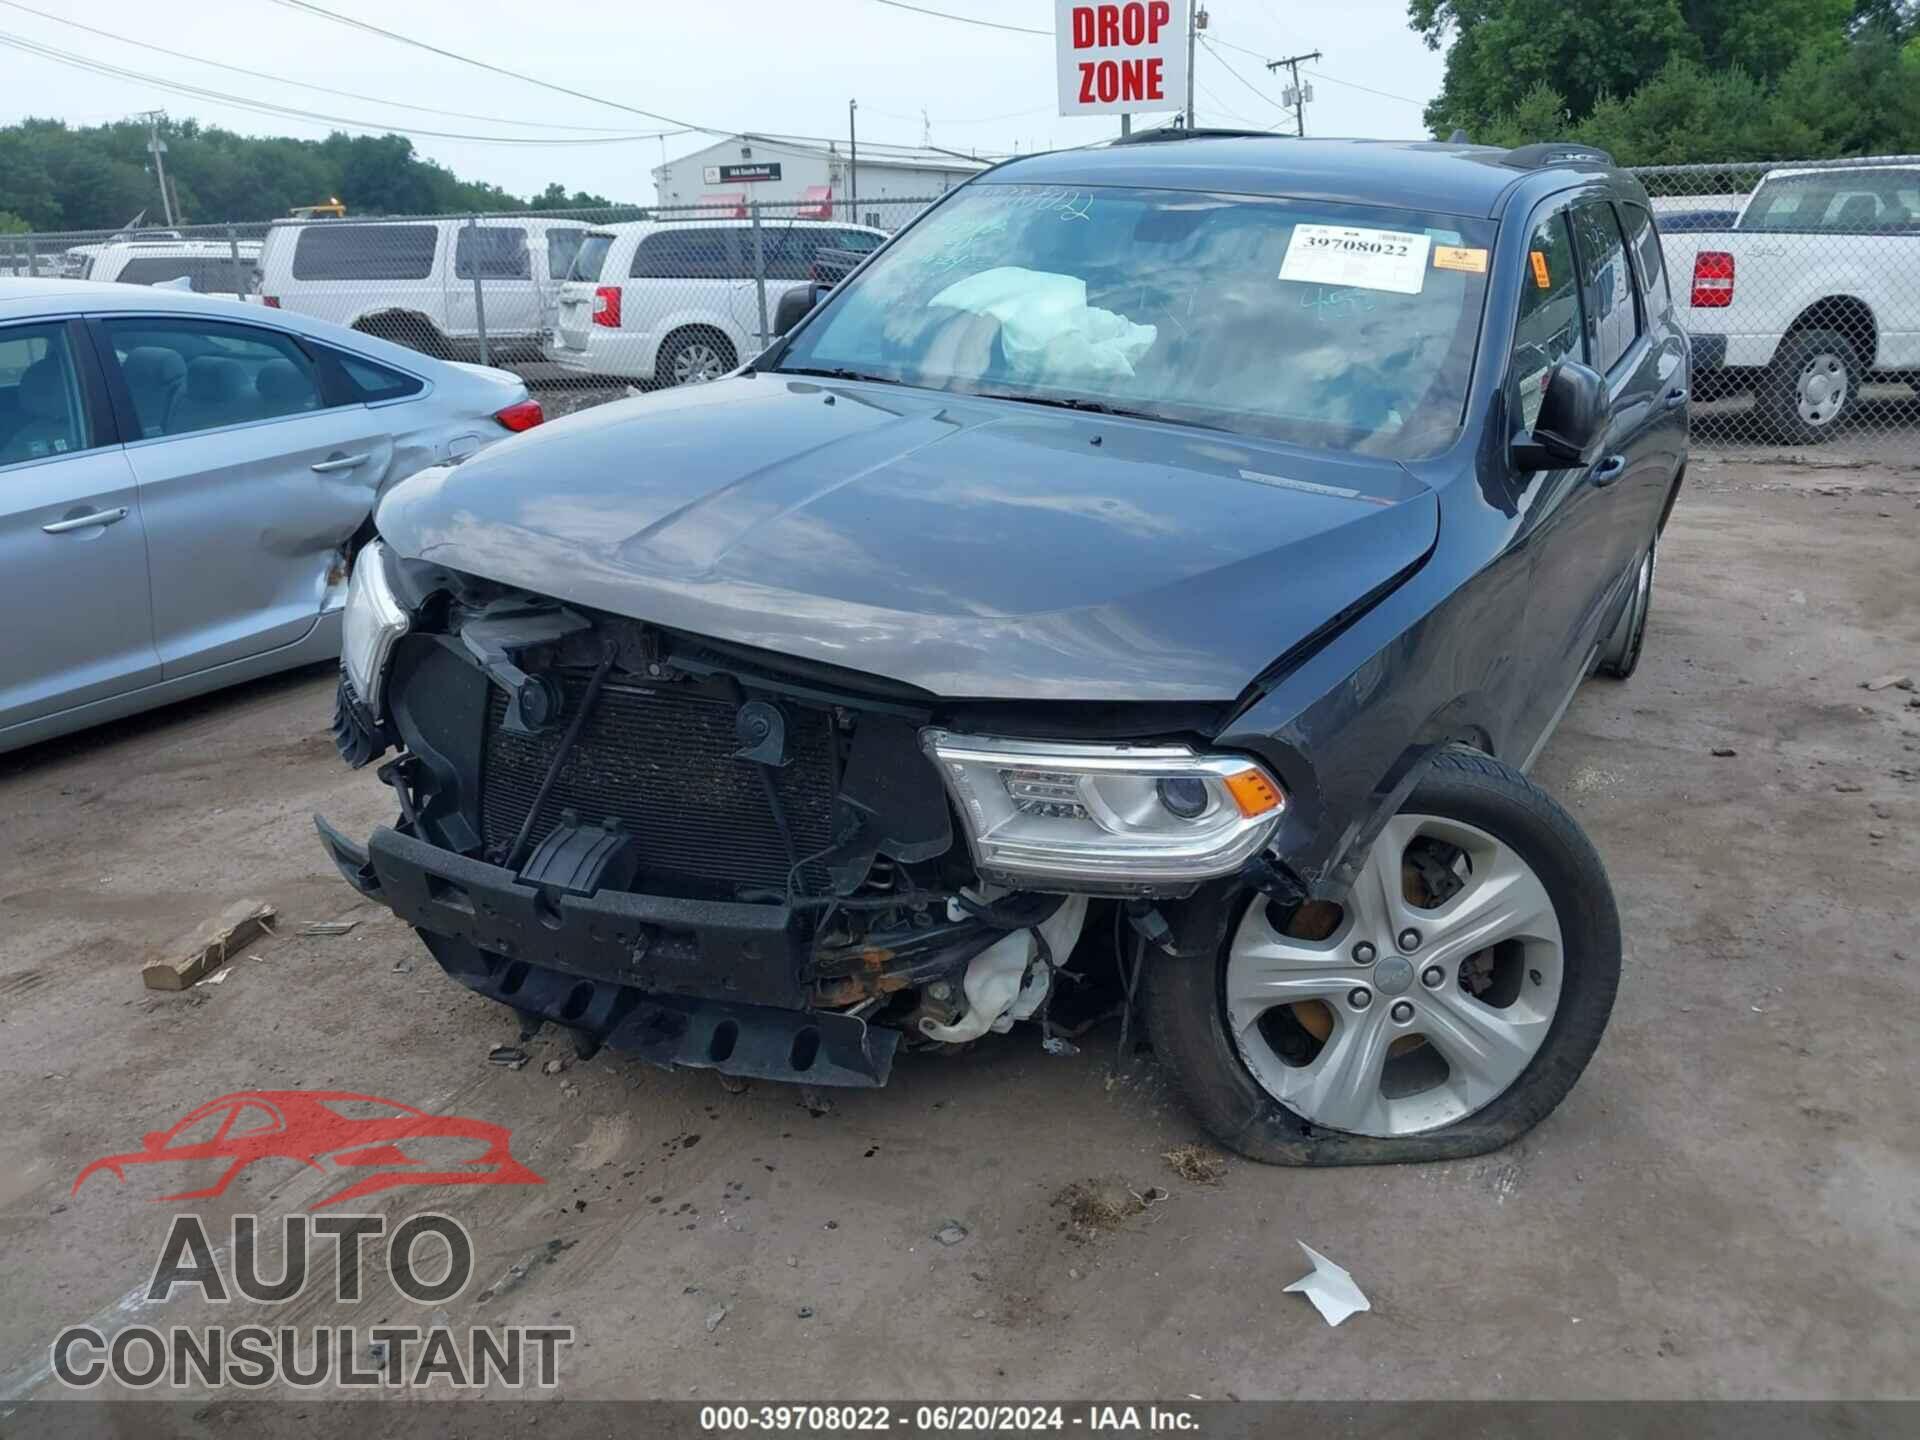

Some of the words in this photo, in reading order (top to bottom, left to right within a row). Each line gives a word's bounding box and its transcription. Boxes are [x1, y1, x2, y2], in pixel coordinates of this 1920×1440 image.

[1073, 1, 1169, 49] DROP
[1079, 58, 1164, 103] ZONE
[1302, 236, 1409, 257] 39708022
